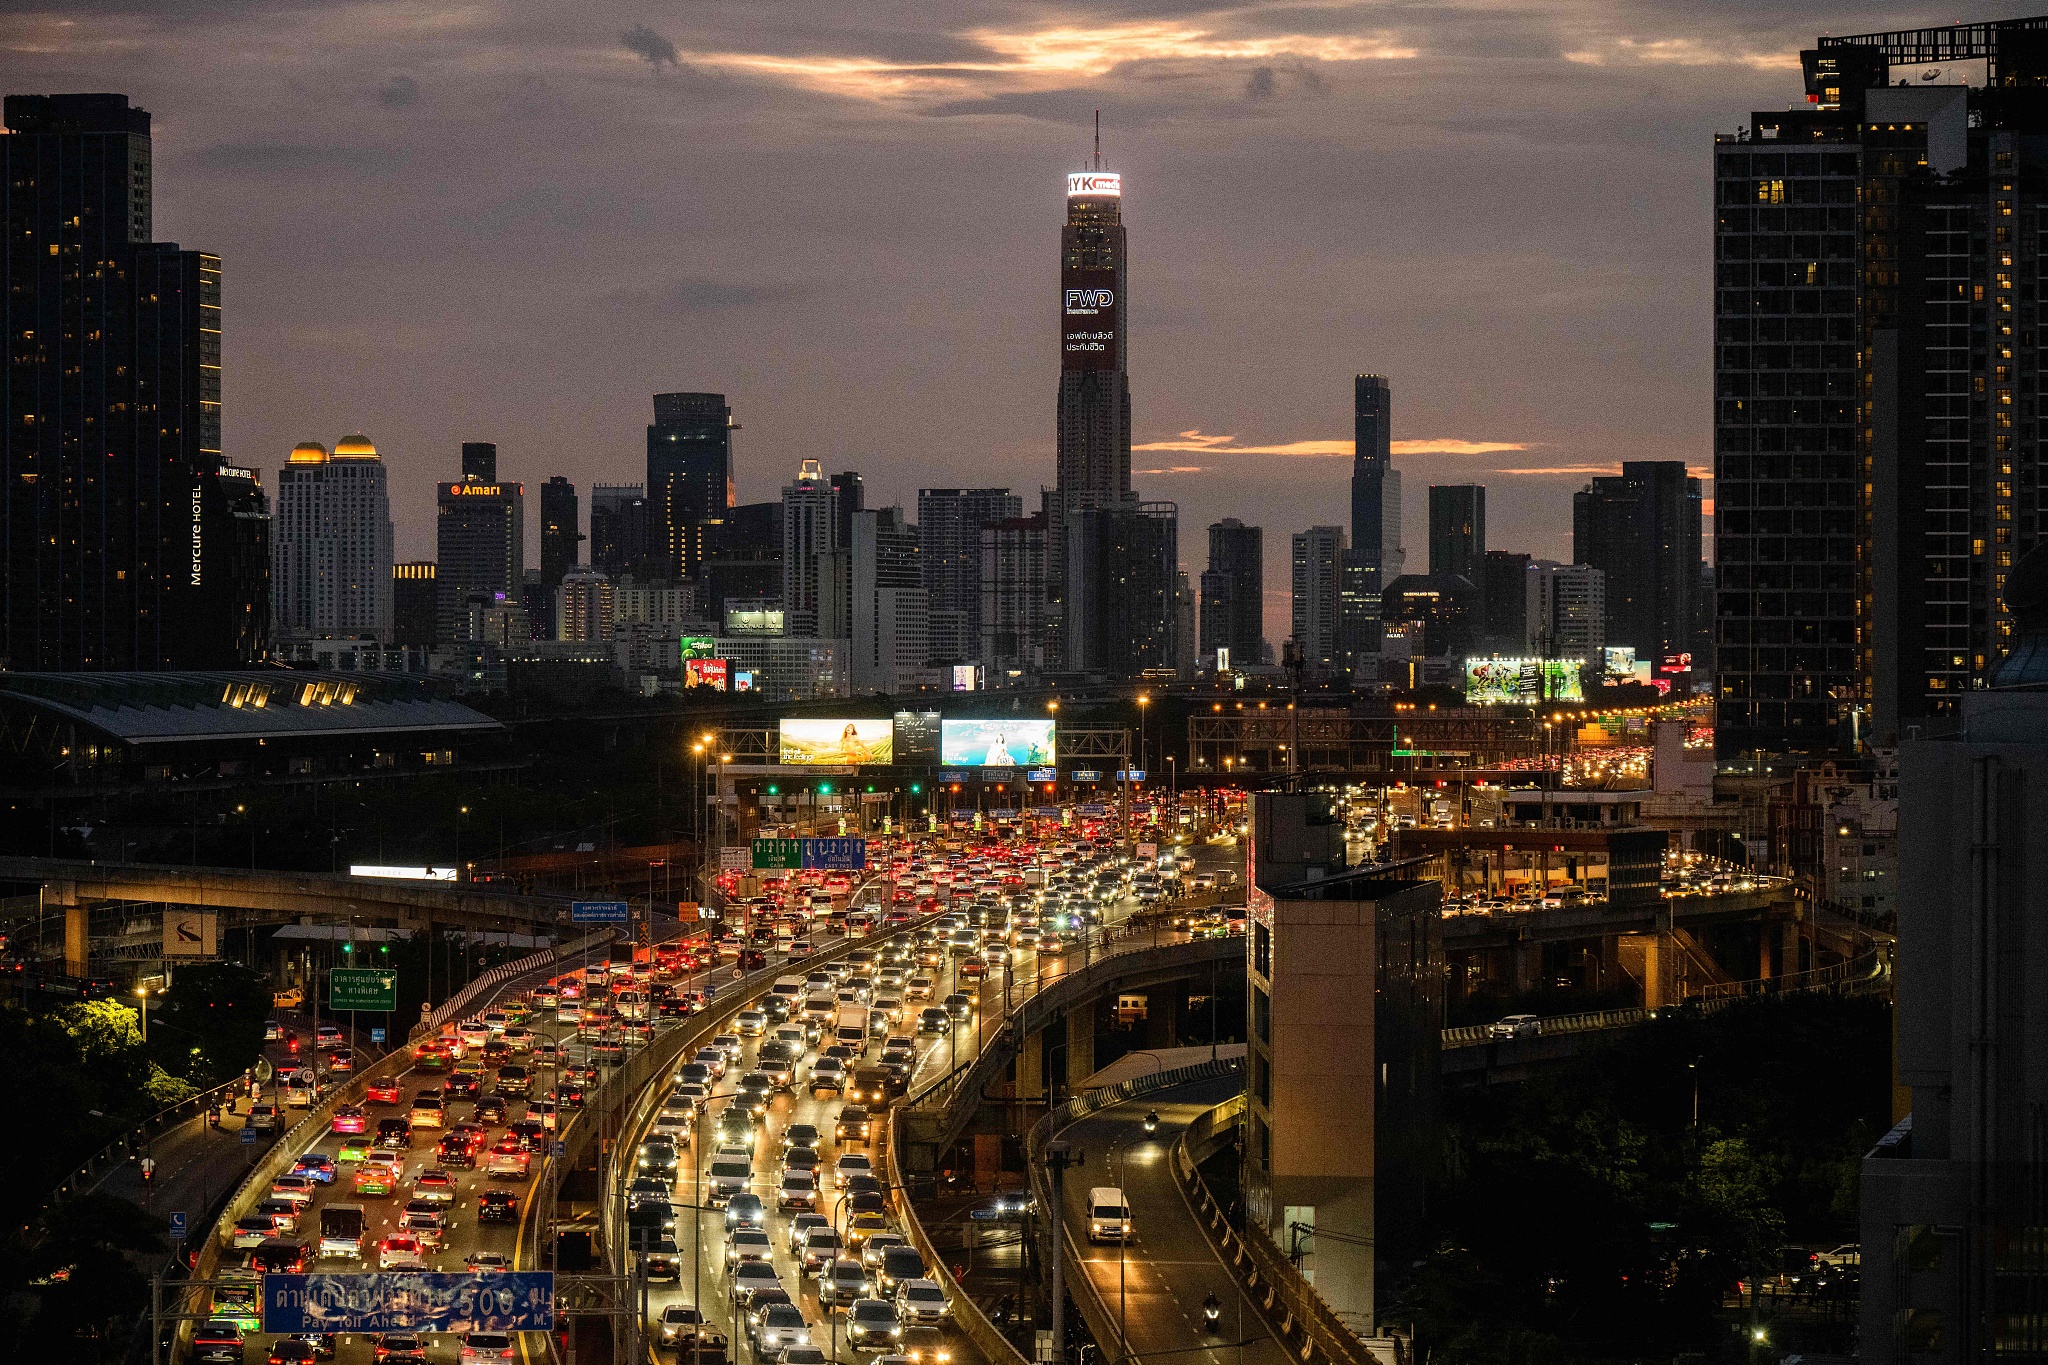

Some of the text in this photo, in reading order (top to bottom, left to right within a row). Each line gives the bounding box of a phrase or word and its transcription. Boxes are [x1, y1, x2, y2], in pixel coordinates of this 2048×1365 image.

[1066, 290, 1114, 307] FWD
[219, 465, 252, 479] Mercure HOTEL
[462, 484, 500, 496] Amari
[190, 485, 201, 586] Mercure HOTEL
[460, 1287, 514, 1317] 500
[302, 1315, 328, 1331] Pay
[369, 1315, 416, 1328] Ahed
